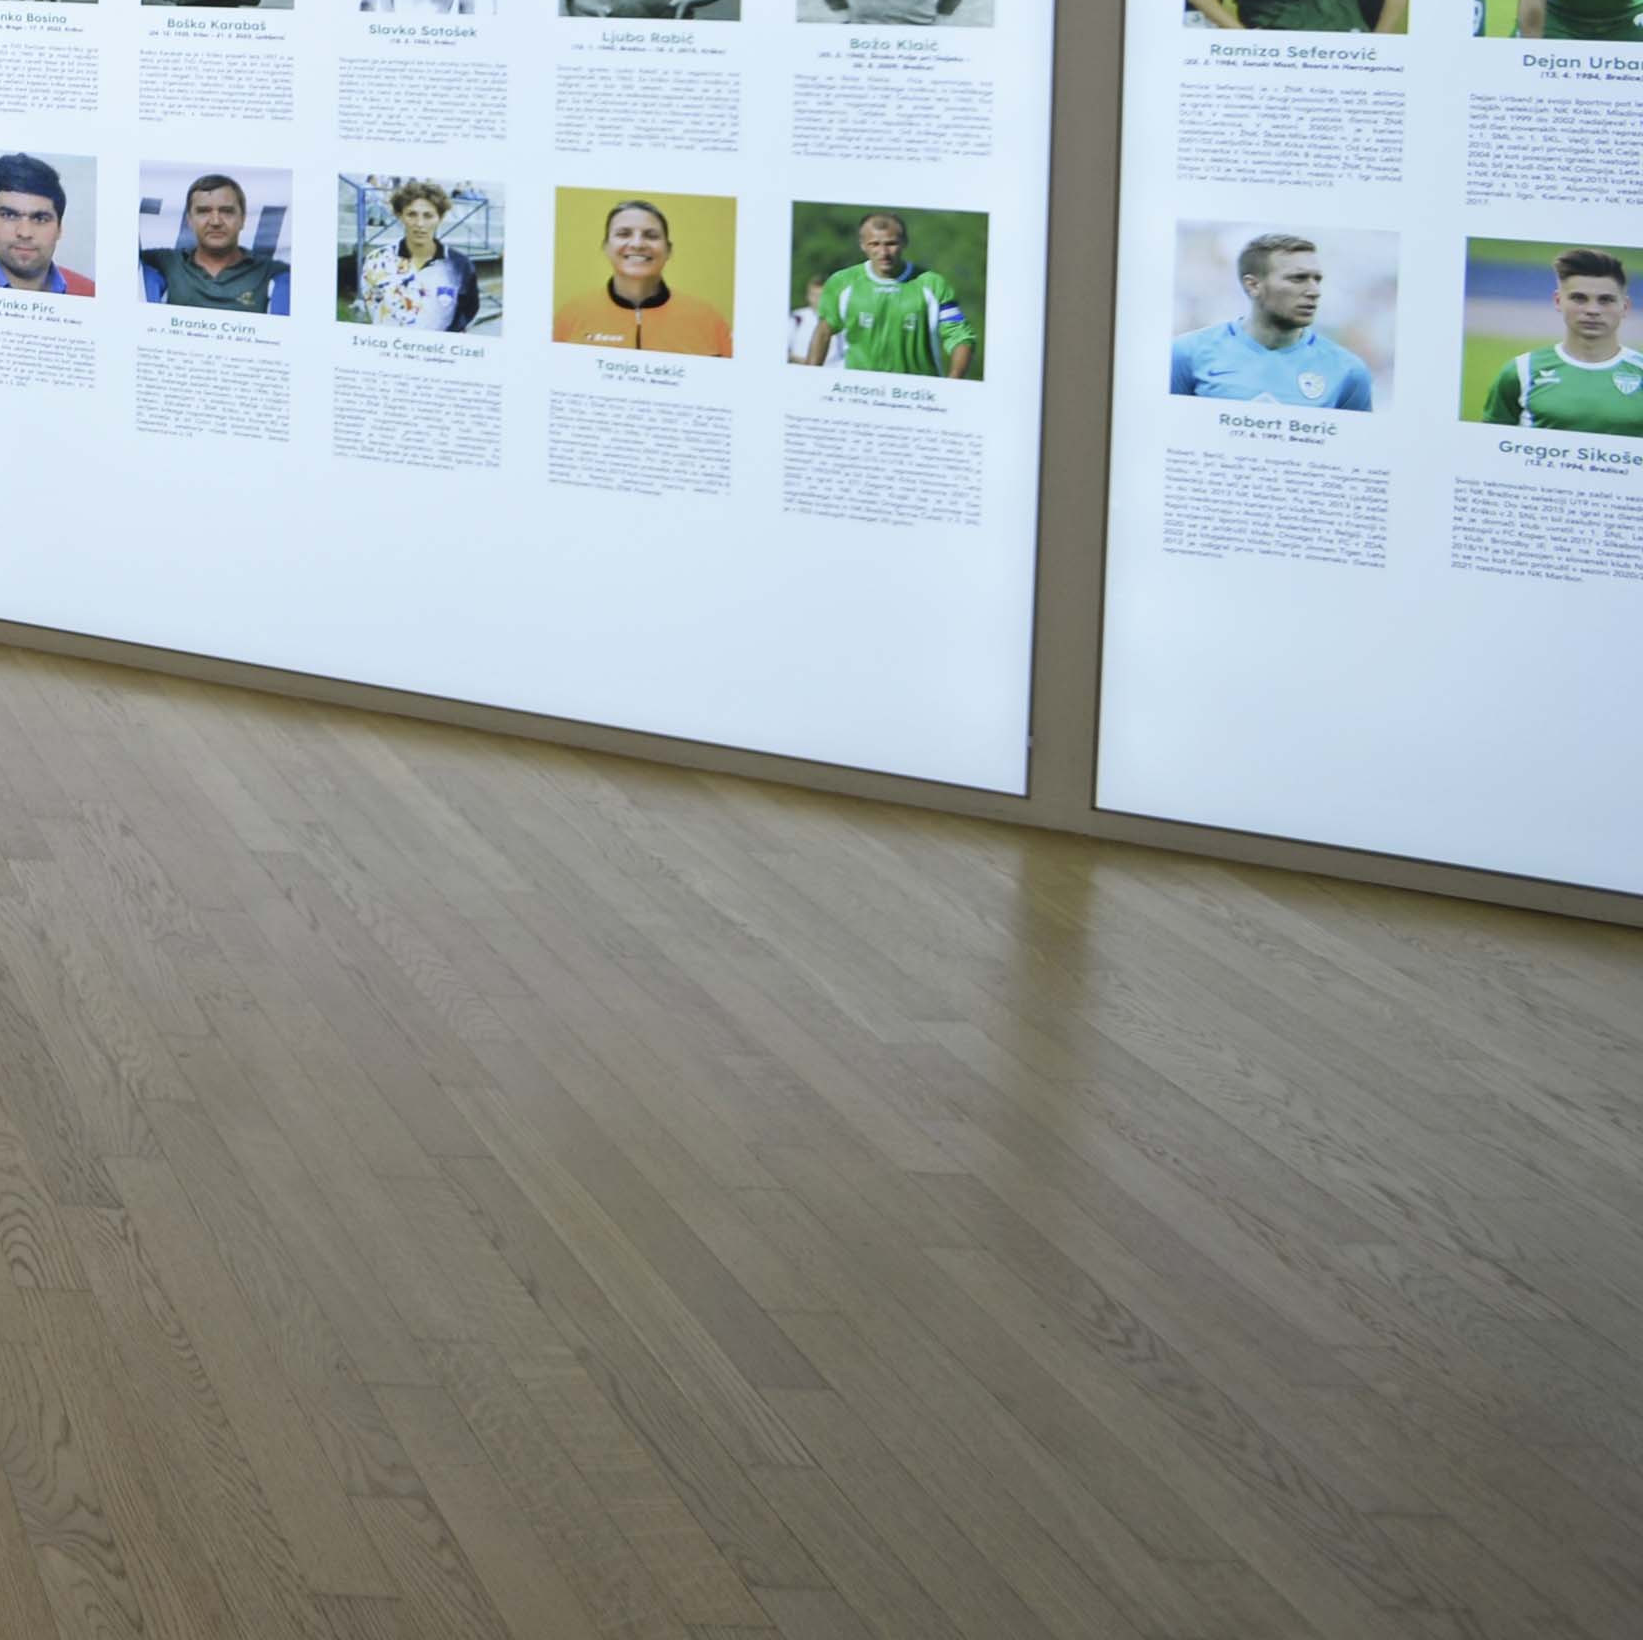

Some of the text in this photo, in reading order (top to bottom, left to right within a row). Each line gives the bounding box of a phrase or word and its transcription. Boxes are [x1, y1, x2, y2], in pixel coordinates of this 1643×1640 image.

[25, 11, 67, 24] Bosina
[166, 16, 267, 31] Boško Karabaš
[368, 23, 417, 36] Slavko
[601, 31, 645, 47] Ljubo
[1209, 42, 1377, 61] Ramiza Seferović
[1522, 53, 1581, 70] Dejan
[31, 301, 55, 314] Pirc
[169, 316, 256, 335] Branko Cvirn
[351, 334, 388, 349] Ivica
[449, 344, 485, 358] Cizel
[595, 358, 639, 375] Tanja
[830, 381, 936, 402] Antoni Brdik
[1218, 412, 1337, 436] Robert Berić
[1497, 439, 1570, 460] Gregor
